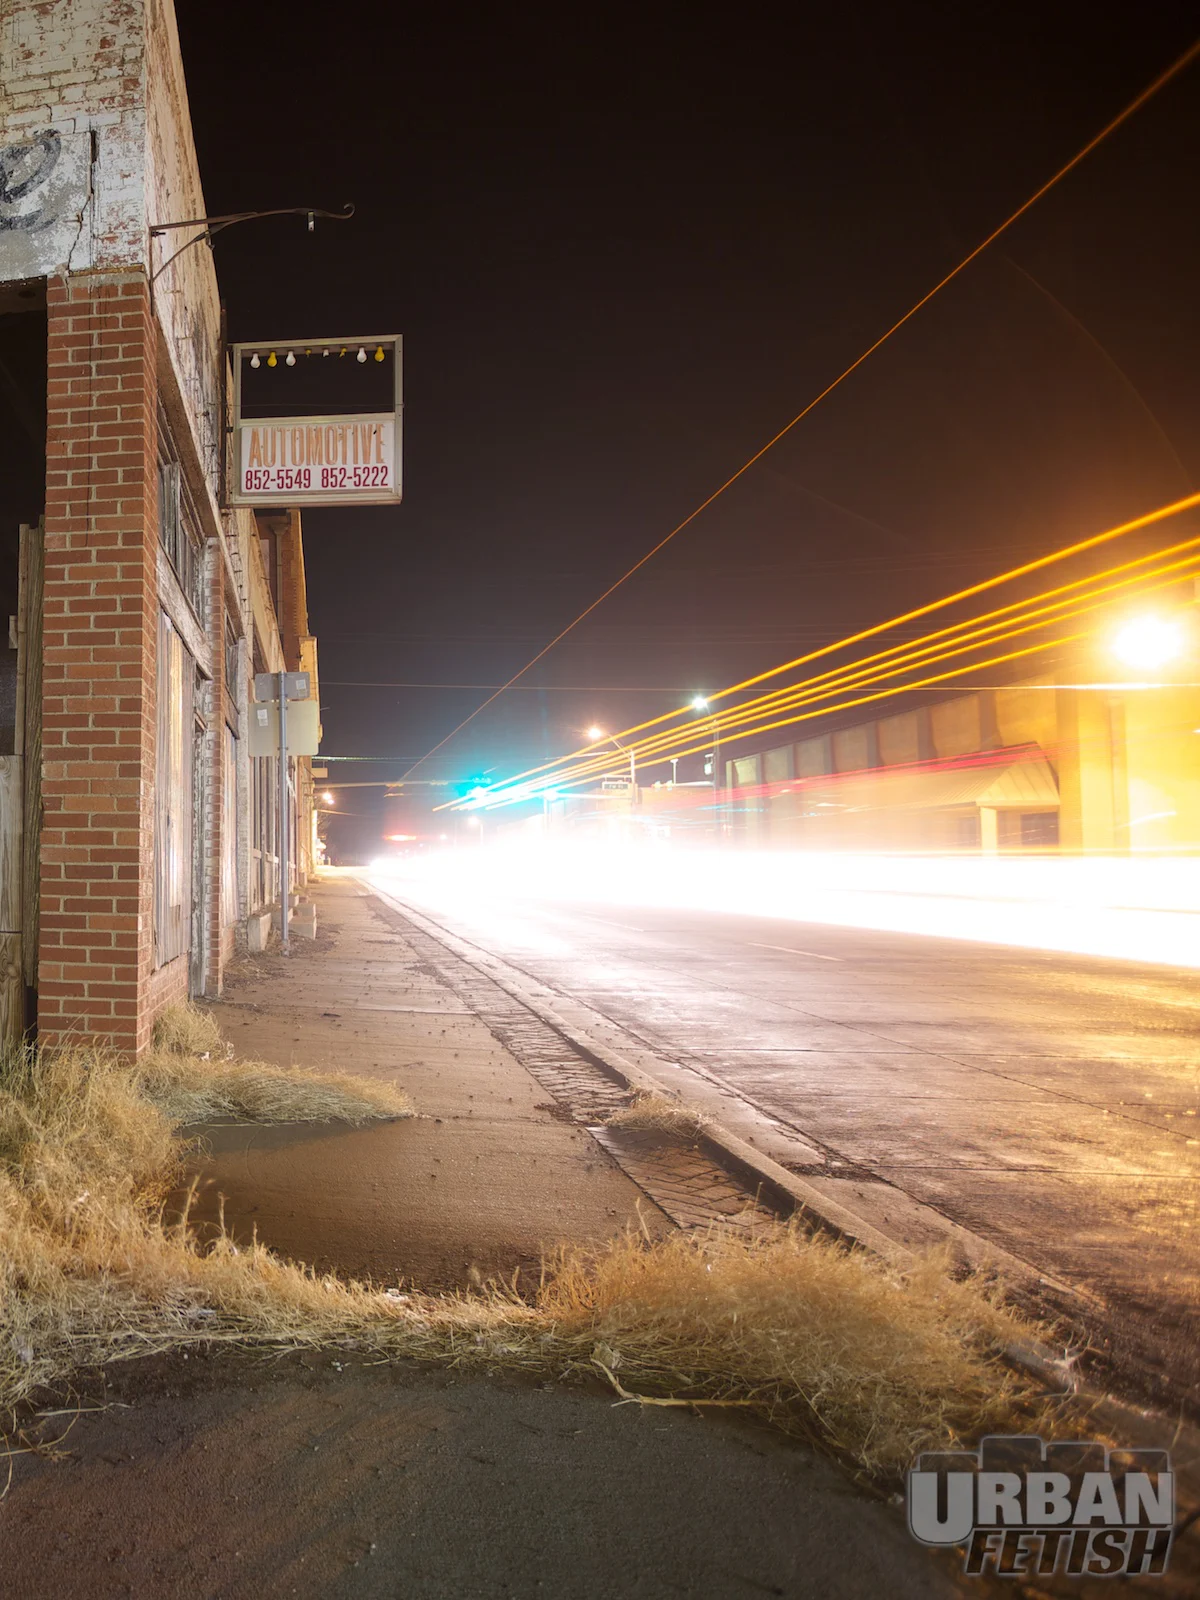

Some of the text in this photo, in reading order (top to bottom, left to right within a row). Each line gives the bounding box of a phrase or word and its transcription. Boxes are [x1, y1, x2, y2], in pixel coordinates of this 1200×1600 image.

[248, 423, 386, 468] AUTOMOTIVE
[245, 465, 389, 490] 852-5549 852-5222
